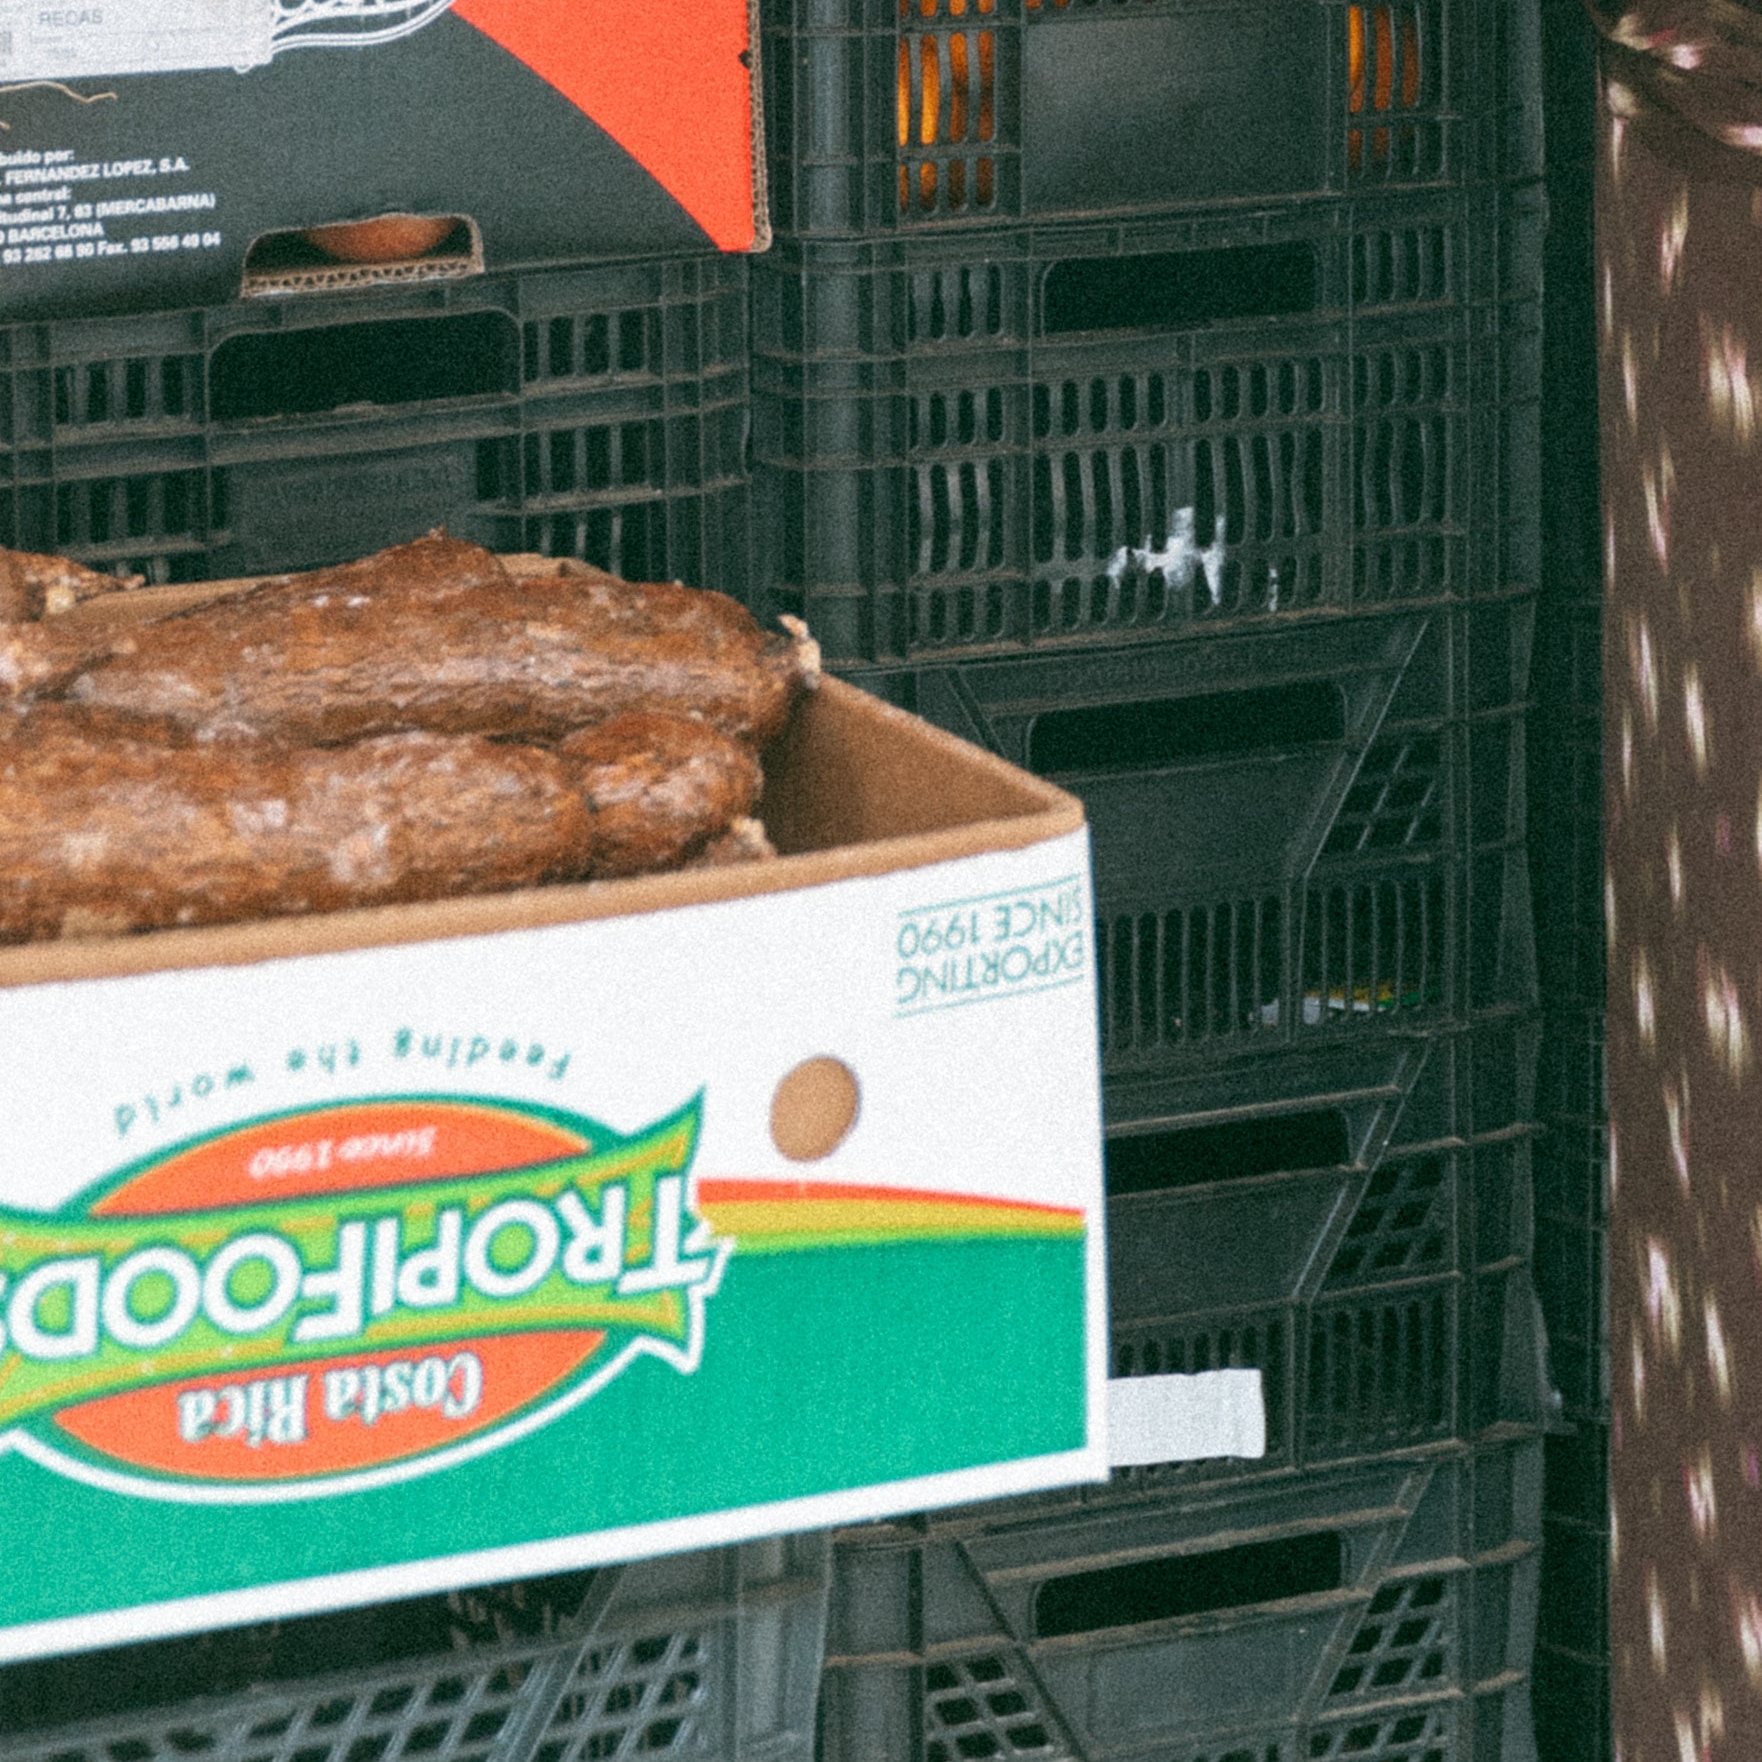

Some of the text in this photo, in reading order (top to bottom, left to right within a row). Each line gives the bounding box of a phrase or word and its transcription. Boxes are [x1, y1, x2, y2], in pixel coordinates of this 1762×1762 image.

[5, 163, 100, 186] FERNANDEZ
[158, 155, 191, 173] S.A.
[7, 220, 105, 245] BARCELONA
[96, 192, 217, 219] (MERCABARNA)
[97, 239, 128, 256] Fax.
[896, 884, 1083, 960] SINCE 1990
[895, 929, 1085, 1005] EXPORTING
[113, 1026, 573, 1136] Feeding the world
[338, 1125, 438, 1163] Since
[0, 1172, 716, 1360] TROPIFOOD
[176, 1351, 483, 1448] Costa Rica
